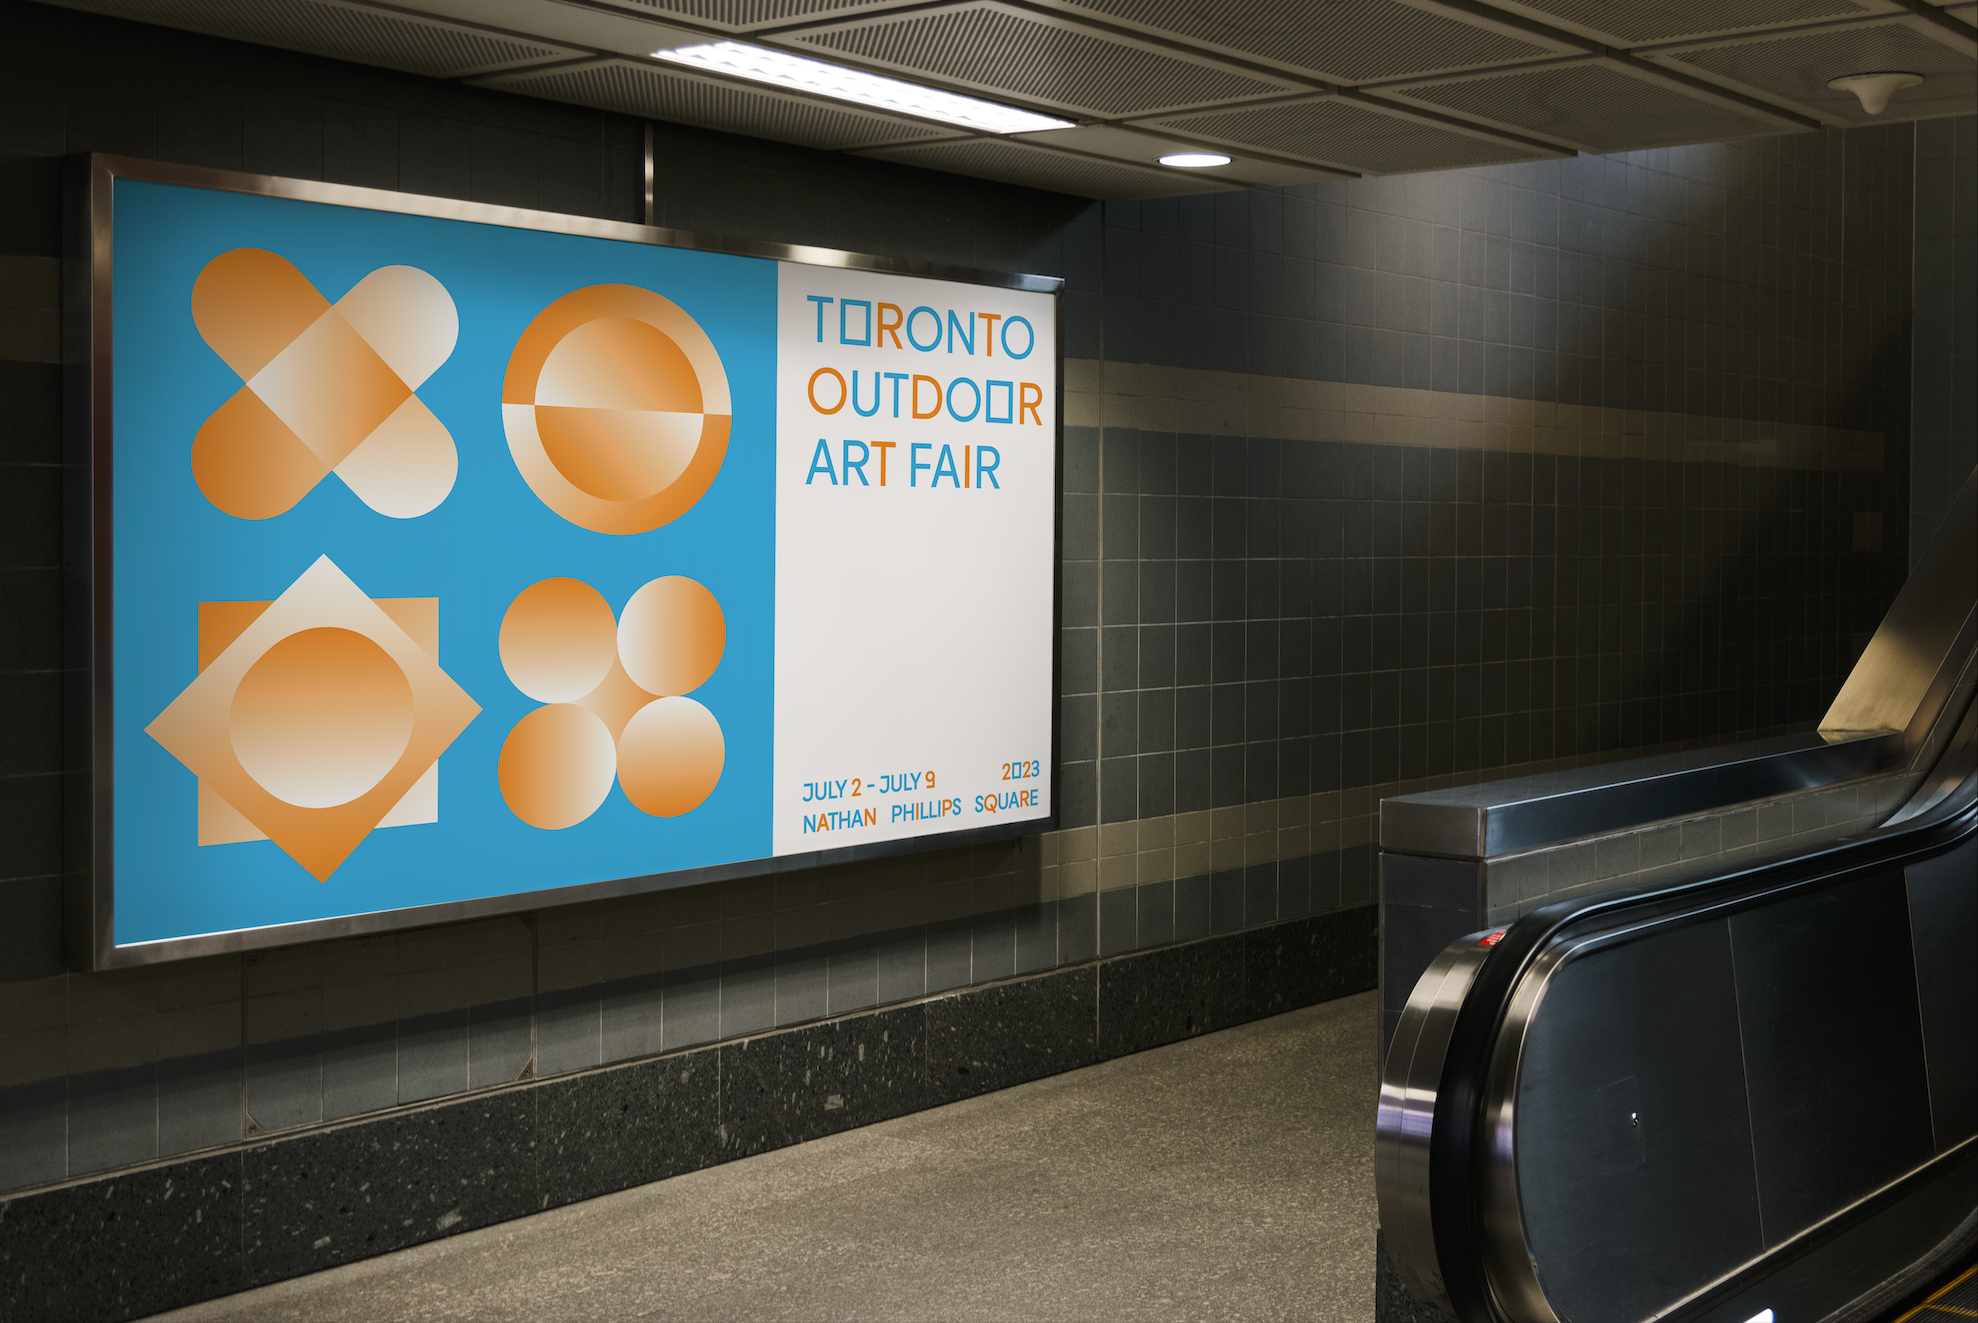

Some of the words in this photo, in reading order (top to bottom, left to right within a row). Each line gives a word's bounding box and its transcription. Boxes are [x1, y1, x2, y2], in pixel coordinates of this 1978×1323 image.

[807, 295, 1035, 360] TORONTO
[807, 367, 1043, 425] OUTDOOR
[805, 438, 897, 487] ART
[910, 442, 1001, 490] FAIR
[802, 779, 848, 802] JULY
[851, 778, 862, 797] 2
[879, 771, 922, 794] JULY
[925, 770, 936, 789] 9
[1002, 760, 1040, 781] 2023
[803, 807, 877, 834] NATHAN
[891, 797, 962, 824] PHILLIPS
[974, 788, 1039, 814] SQUARE
